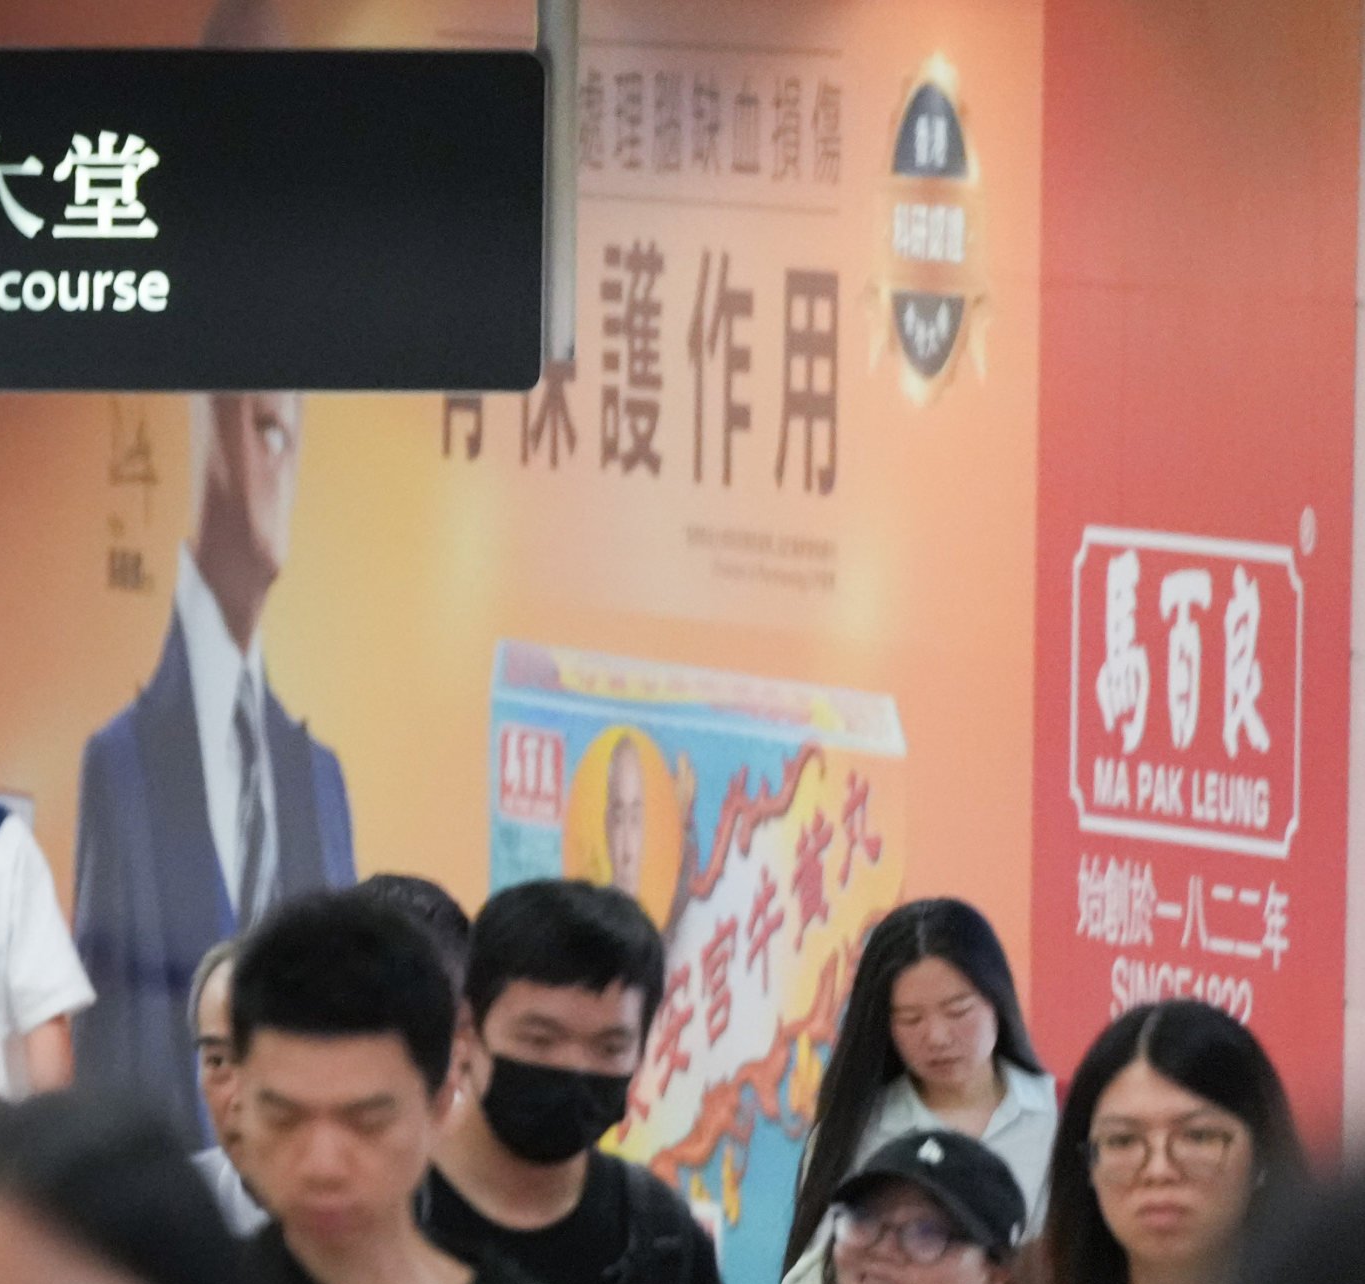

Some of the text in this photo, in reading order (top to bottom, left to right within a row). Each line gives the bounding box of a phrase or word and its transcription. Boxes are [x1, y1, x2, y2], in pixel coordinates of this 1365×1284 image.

[1095, 548, 1272, 760] 馬百良
[1092, 756, 1271, 831] MA PAK LEUNG
[1074, 852, 1291, 971] 始創於一八二二年
